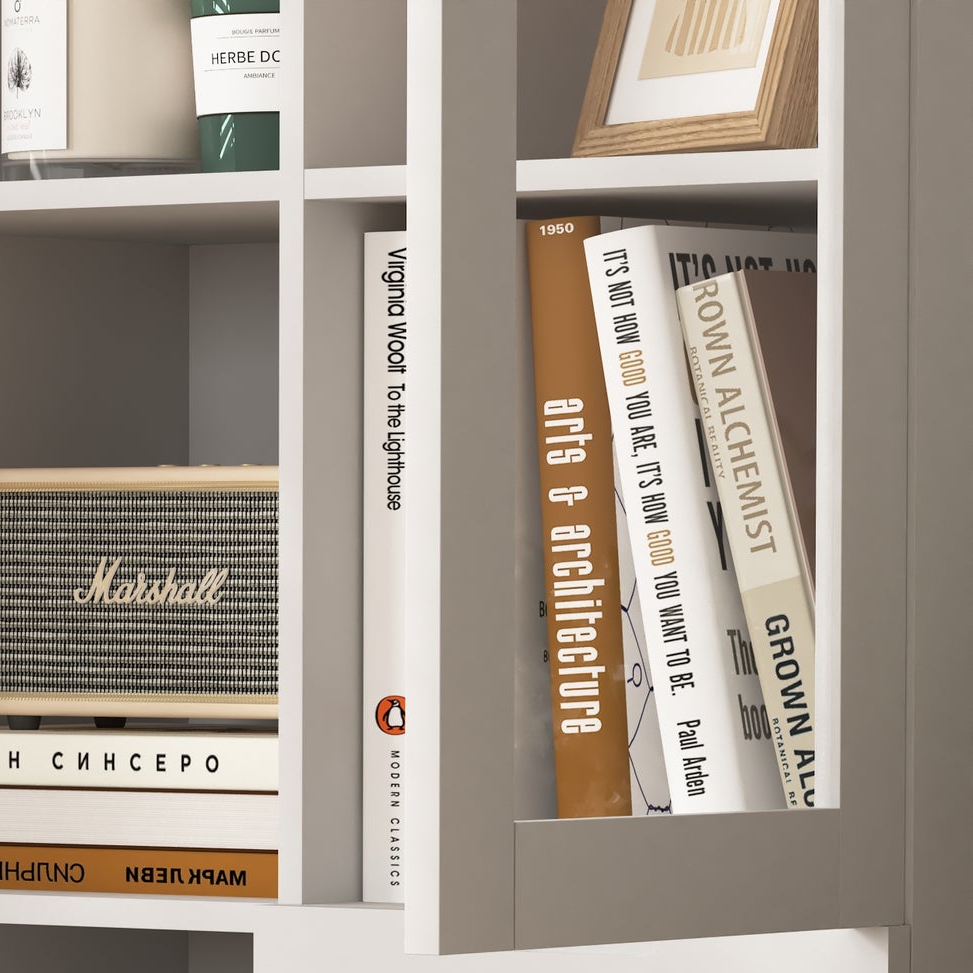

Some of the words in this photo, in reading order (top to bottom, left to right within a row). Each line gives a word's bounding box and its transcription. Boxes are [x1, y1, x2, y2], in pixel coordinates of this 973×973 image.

[211, 50, 256, 65] HERBE
[538, 222, 575, 236] 1950
[602, 248, 630, 278] IT'S
[381, 247, 407, 317] Virginia
[607, 280, 635, 308] NOT
[612, 312, 641, 345] HOW
[618, 348, 647, 387] GOOD
[387, 382, 406, 401] To
[625, 390, 653, 421] YOU
[387, 403, 406, 429] the
[543, 397, 593, 466] arts
[629, 424, 658, 458] ARE,
[382, 431, 406, 512] Lighthouse
[635, 461, 664, 489] IT'S
[714, 386, 777, 554] ALCHEMIST
[640, 492, 670, 525] HOW
[646, 528, 675, 567] GOOD
[73, 556, 229, 605] Marshall
[653, 570, 682, 601] YOU
[550, 523, 606, 735] architecture
[658, 604, 688, 644] WANT
[665, 648, 692, 668] TO
[669, 672, 695, 697] BE.
[764, 613, 813, 737] GROWN
[677, 718, 705, 751] Paul
[51, 751, 220, 774] СИНСЕРО
[389, 750, 401, 808] MODERN
[682, 755, 710, 797] Arden
[389, 817, 401, 887] CLASSICS
